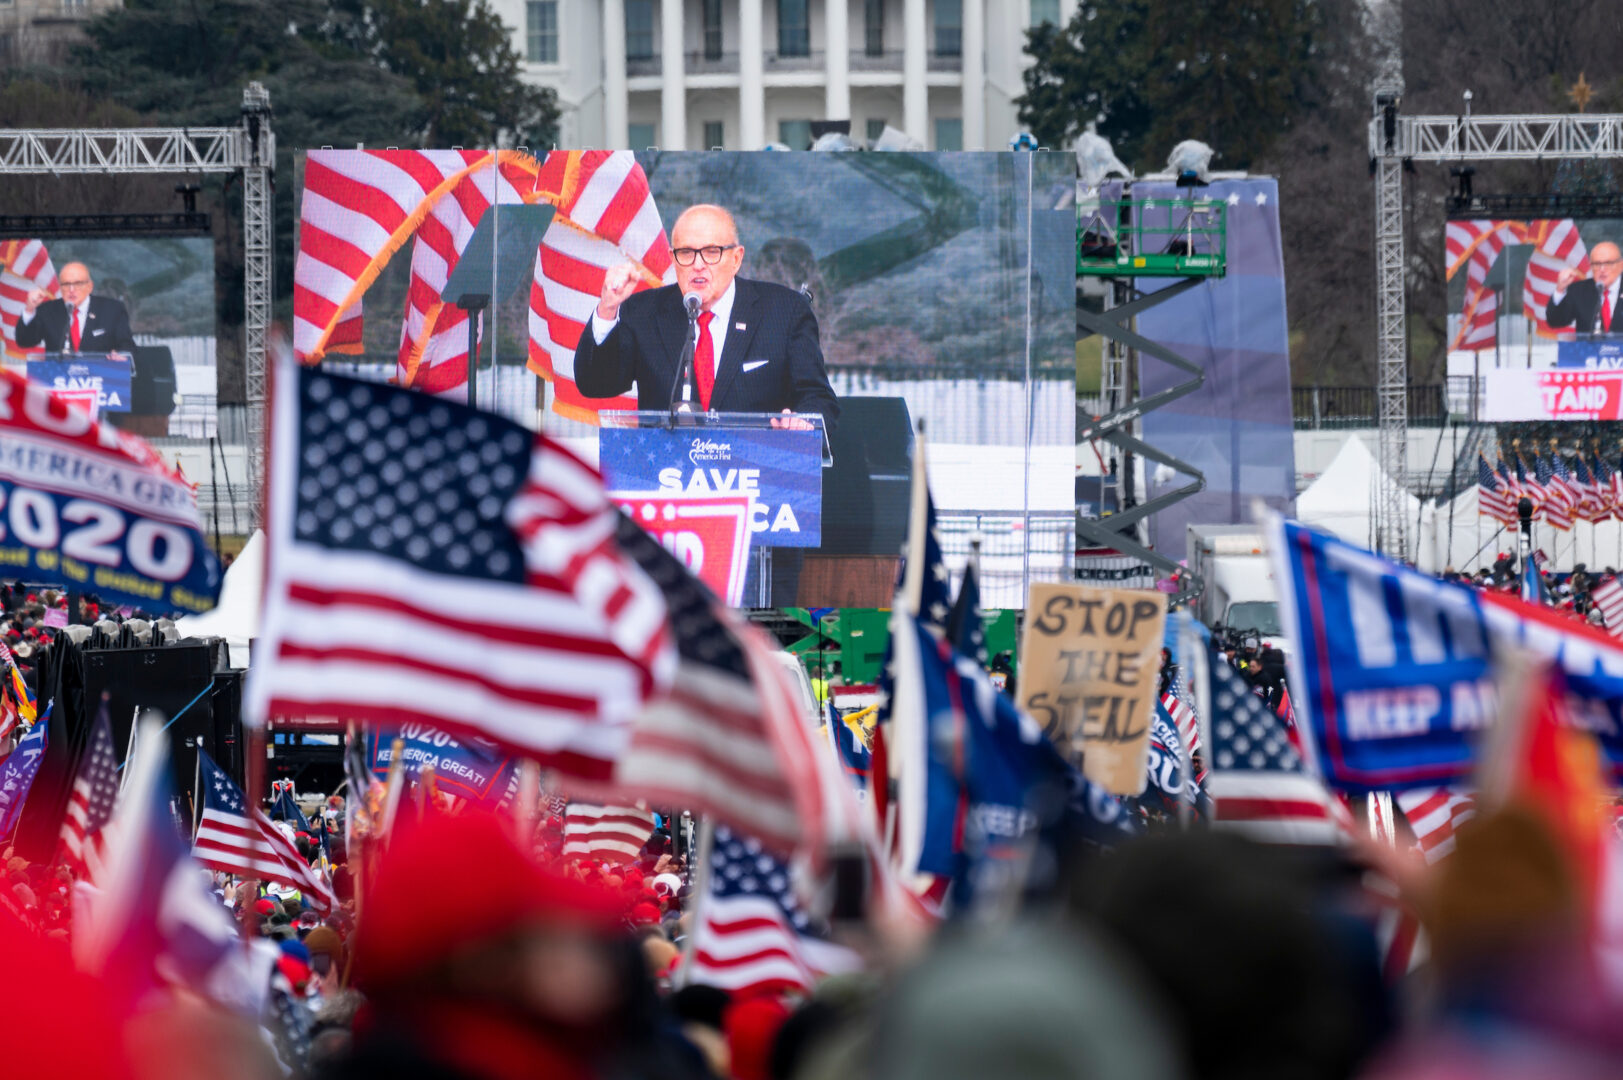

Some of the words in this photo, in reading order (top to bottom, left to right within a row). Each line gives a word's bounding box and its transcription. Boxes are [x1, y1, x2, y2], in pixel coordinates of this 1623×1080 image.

[1585, 356, 1623, 371] SAV
[54, 376, 104, 391] SAVE
[1543, 386, 1608, 410] TAND
[691, 437, 731, 451] Women
[0, 443, 123, 495] MERICA
[658, 467, 761, 498] SAVE
[750, 503, 800, 532] CA
[0, 484, 193, 582] 020
[1032, 595, 1159, 640] STOP
[1057, 649, 1144, 687] THE
[1344, 685, 1442, 741] KEEP
[440, 758, 486, 787] GREAT!
